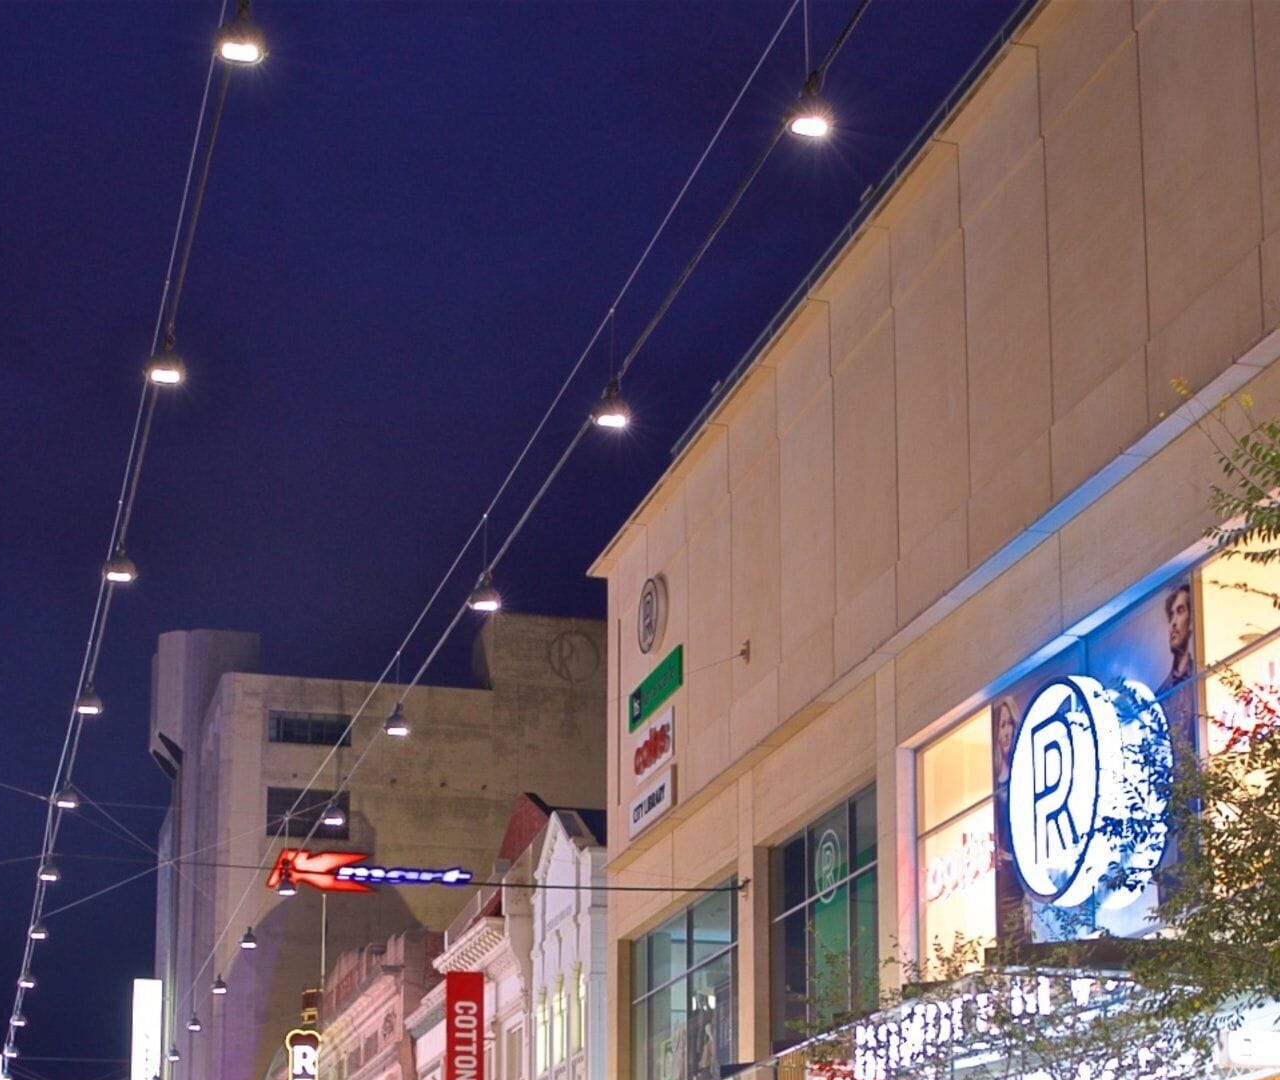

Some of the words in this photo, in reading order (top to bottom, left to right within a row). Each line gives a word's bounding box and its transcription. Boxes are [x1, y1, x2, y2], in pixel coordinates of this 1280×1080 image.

[632, 801, 645, 825] CITY
[645, 782, 666, 817] LIBRARY
[267, 848, 472, 893] Kmart
